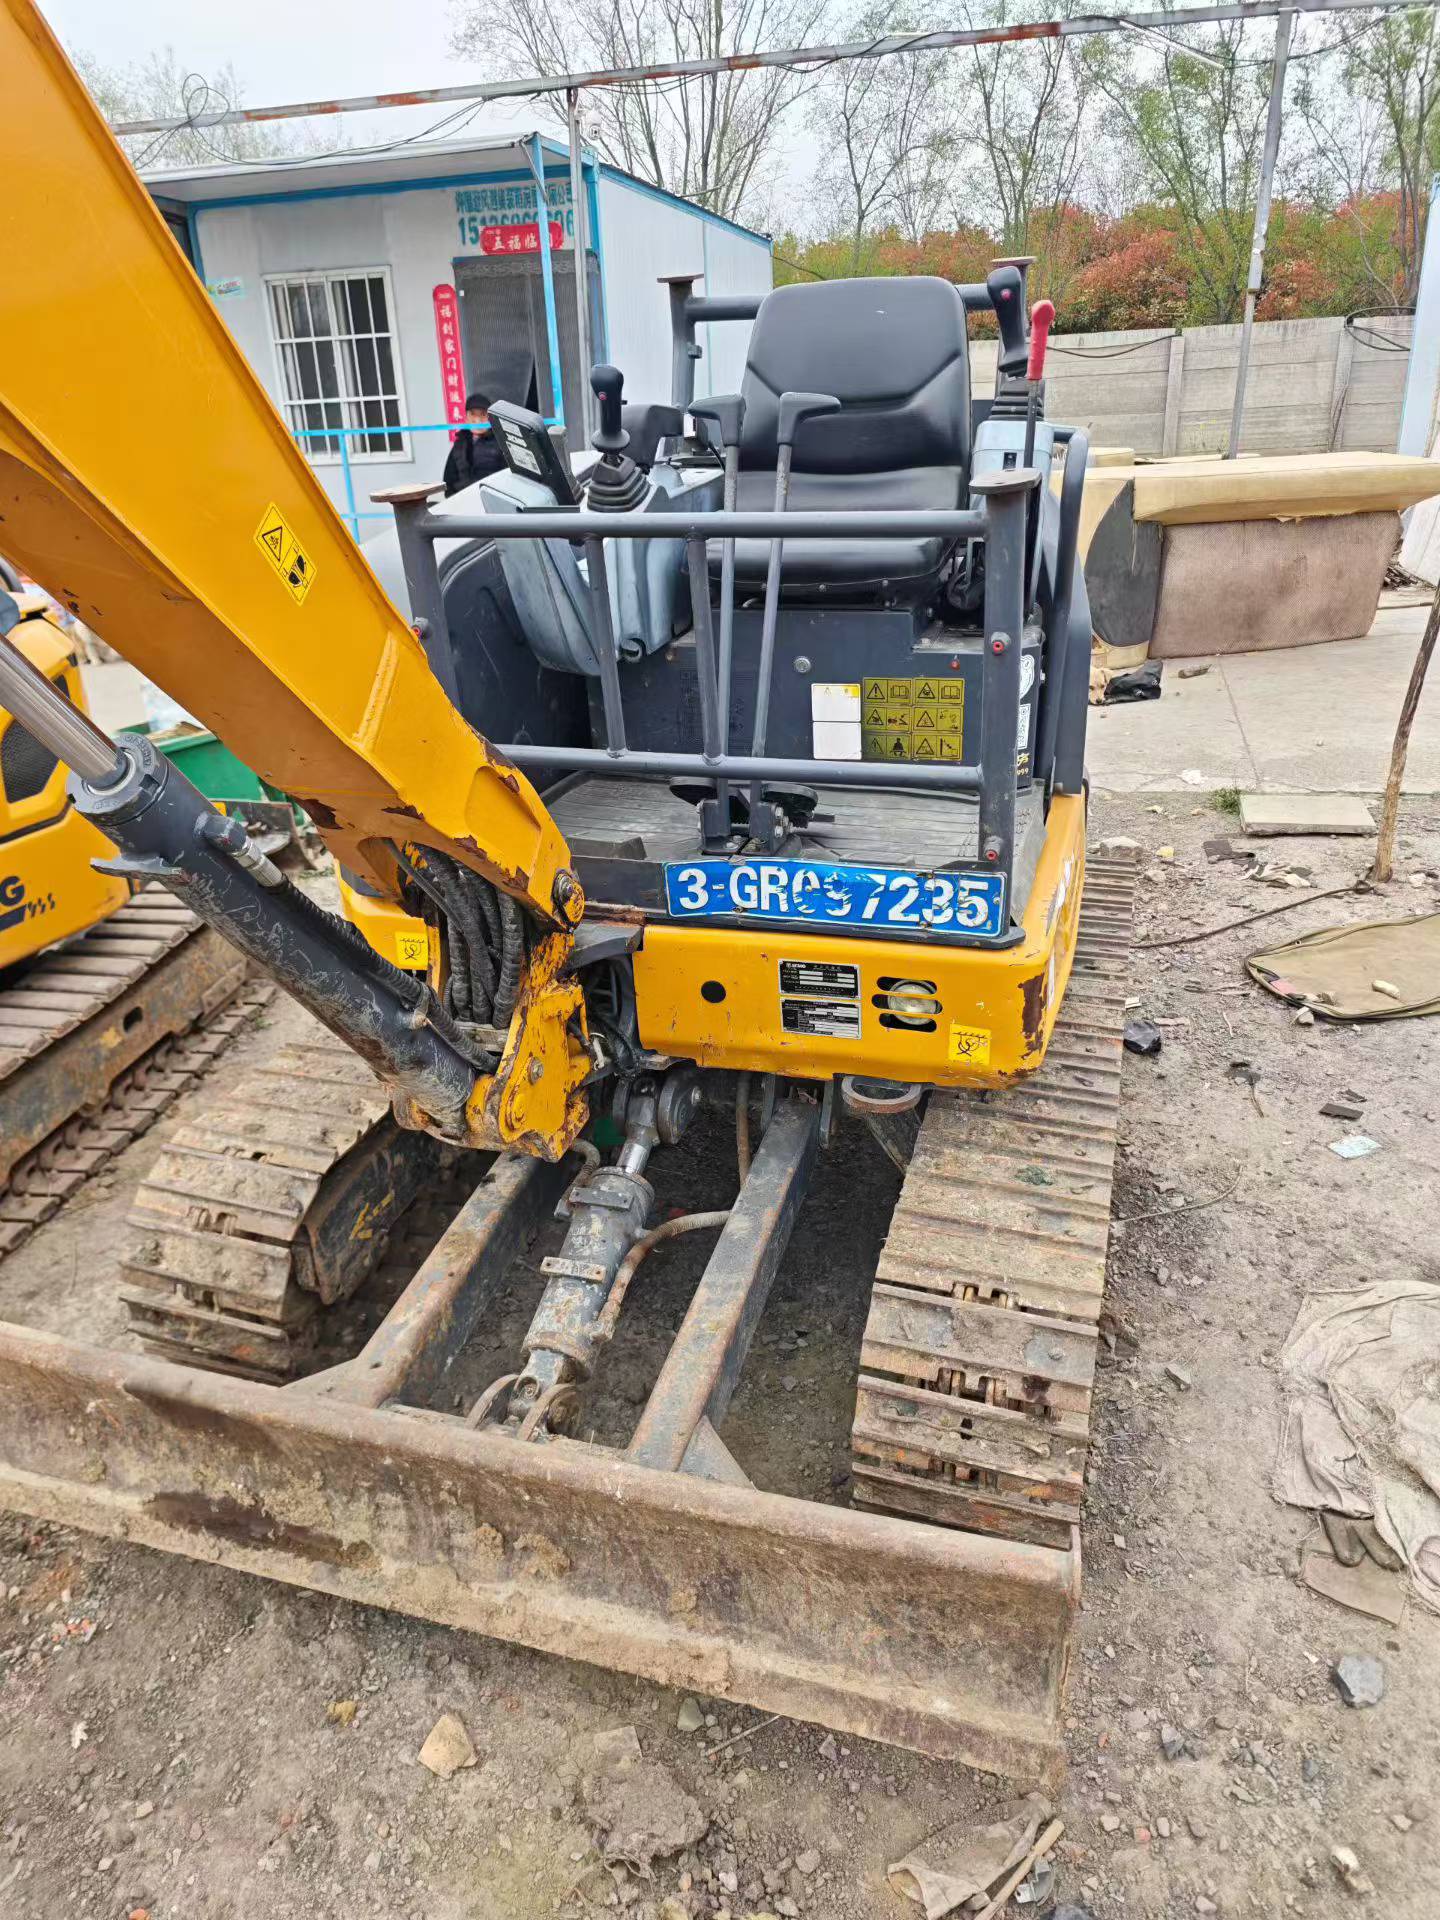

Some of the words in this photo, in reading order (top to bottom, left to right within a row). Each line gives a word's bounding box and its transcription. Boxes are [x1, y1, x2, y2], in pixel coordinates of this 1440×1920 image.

[492, 232, 553, 251] 五福临
[677, 866, 989, 928] 3-GR097235
